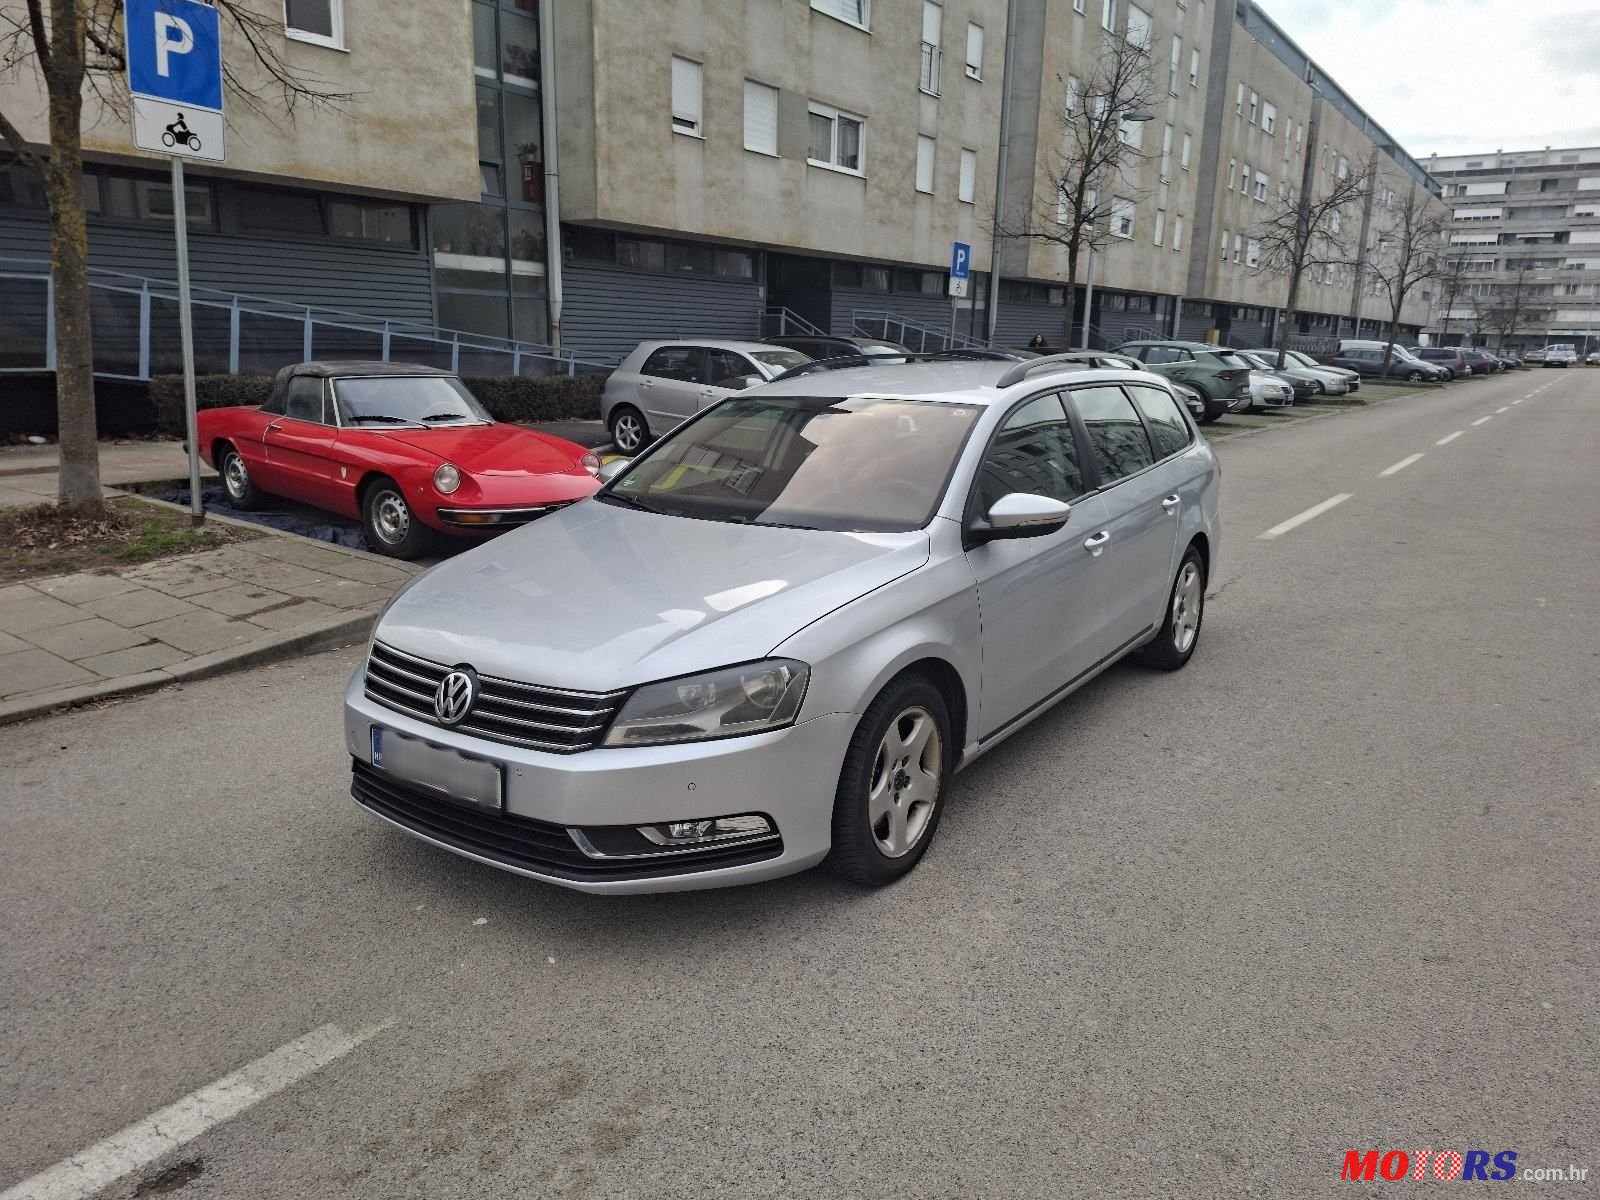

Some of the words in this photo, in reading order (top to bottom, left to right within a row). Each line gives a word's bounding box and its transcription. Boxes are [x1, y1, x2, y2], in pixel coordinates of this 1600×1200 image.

[154, 11, 194, 78] P
[957, 249, 966, 271] P
[435, 672, 472, 724] VW
